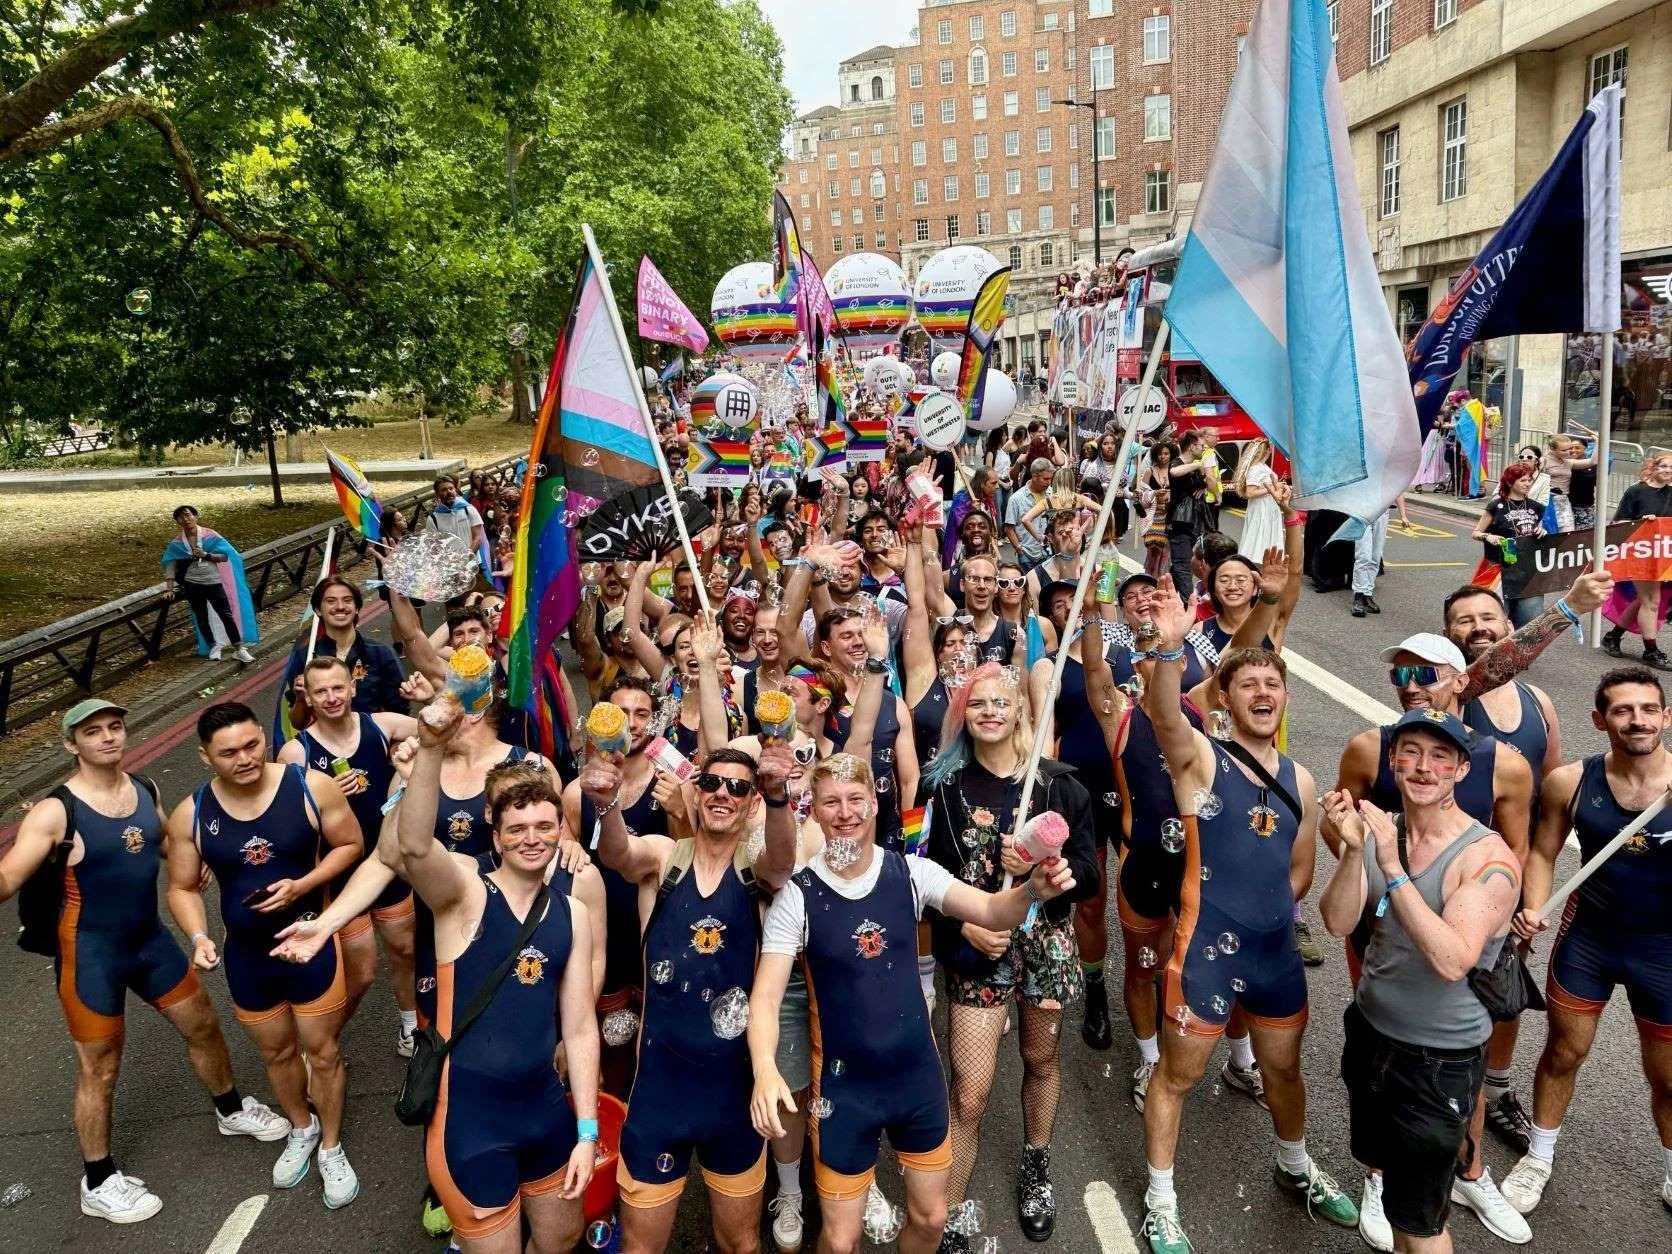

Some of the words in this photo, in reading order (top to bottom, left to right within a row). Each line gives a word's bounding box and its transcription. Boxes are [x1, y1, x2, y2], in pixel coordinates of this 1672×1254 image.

[1471, 245, 1524, 295] OTTE
[932, 279, 965, 287] UNIVERSITY
[641, 303, 689, 325] BINARY
[923, 404, 952, 423] UNIVERSITY
[1123, 404, 1161, 415] ZOIAC
[926, 416, 961, 438] WESTMINSTER
[937, 416, 944, 424] OF
[585, 495, 674, 554] DYKE
